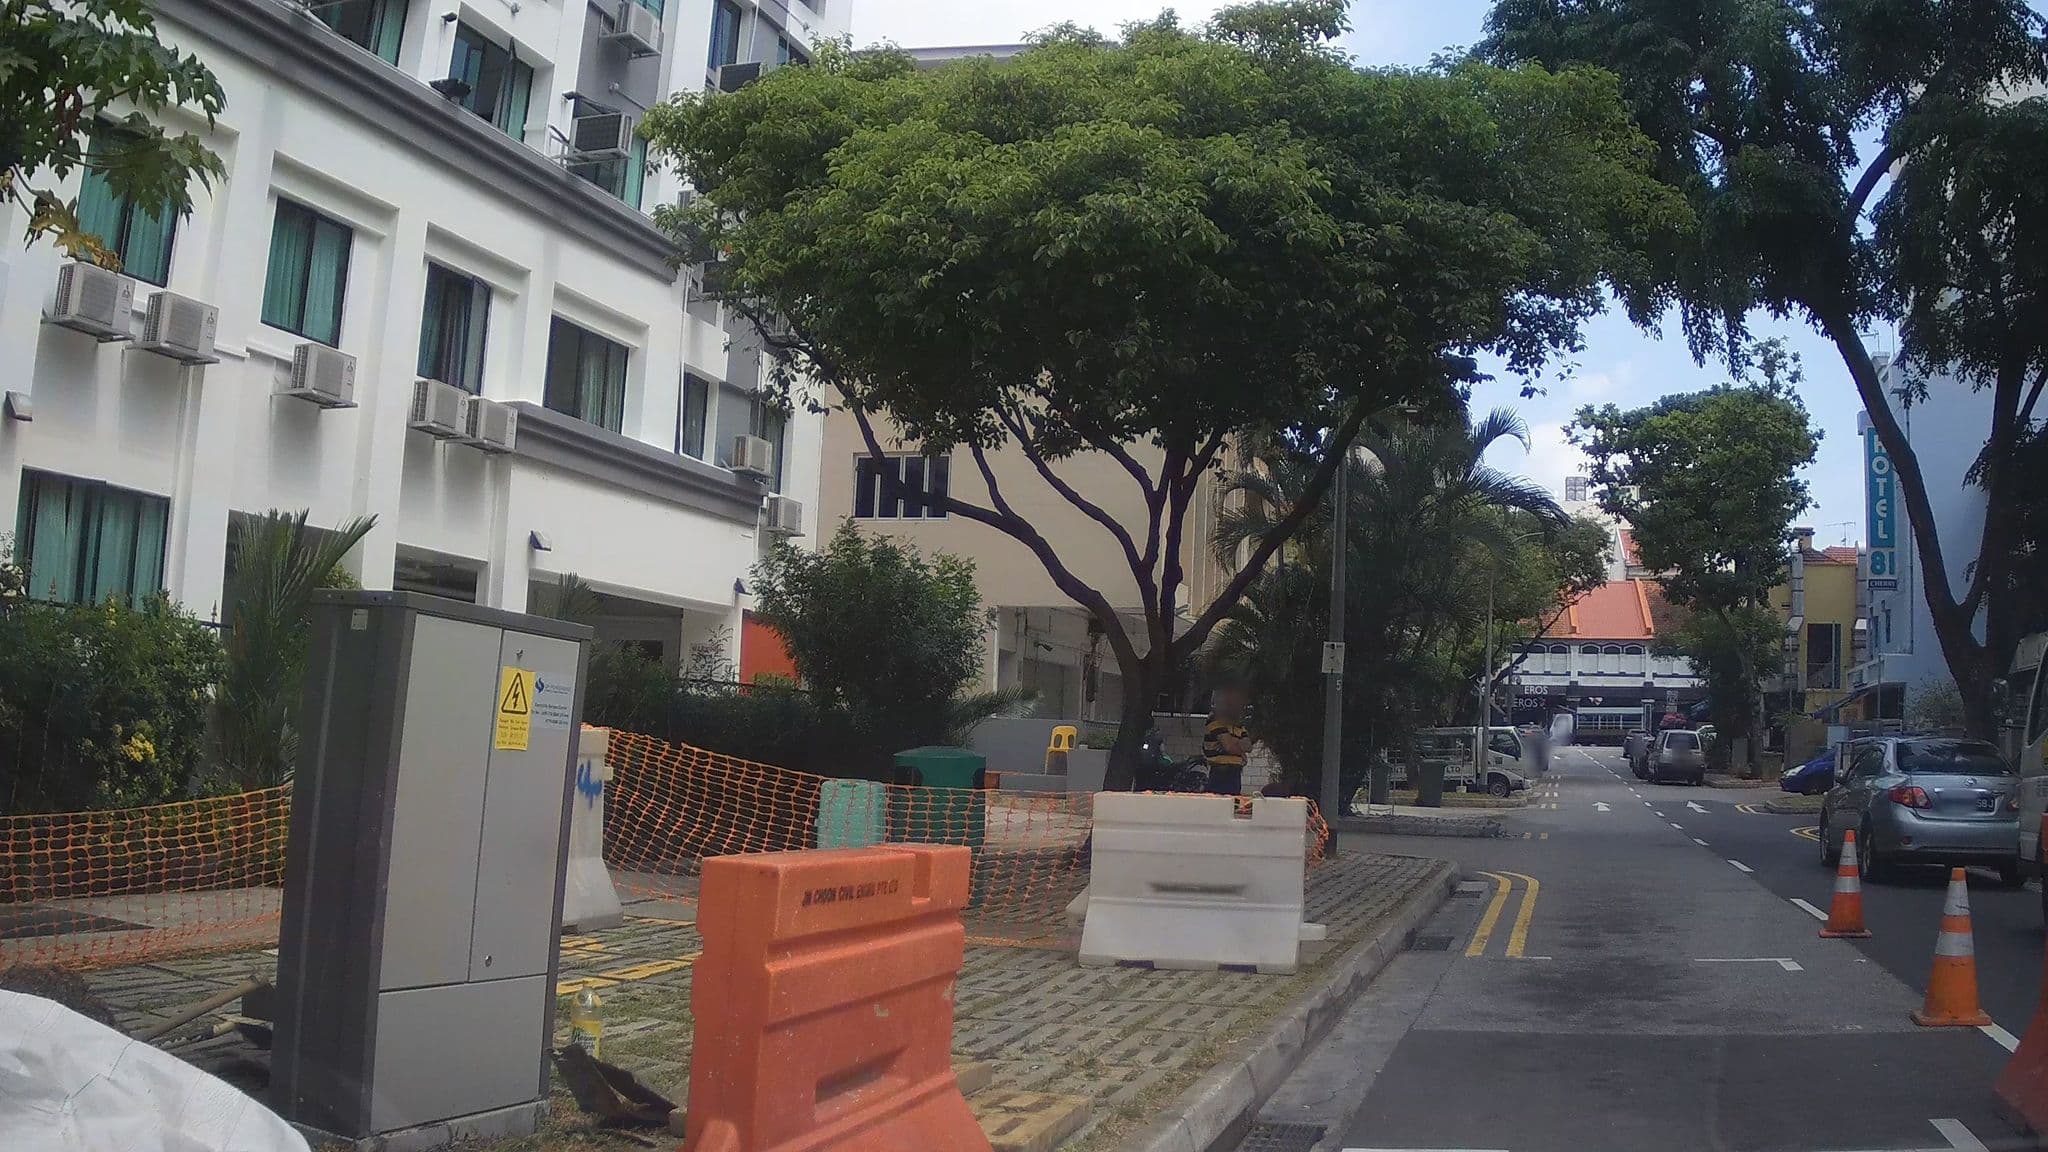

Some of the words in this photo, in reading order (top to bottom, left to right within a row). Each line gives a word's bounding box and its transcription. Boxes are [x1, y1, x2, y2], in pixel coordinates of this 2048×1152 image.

[1872, 434, 1891, 540] HOTEL
[1871, 551, 1895, 576] 81
[1870, 580, 1896, 588] CHERRY
[1524, 685, 1549, 695] EROS
[1513, 697, 1538, 709] EROS
